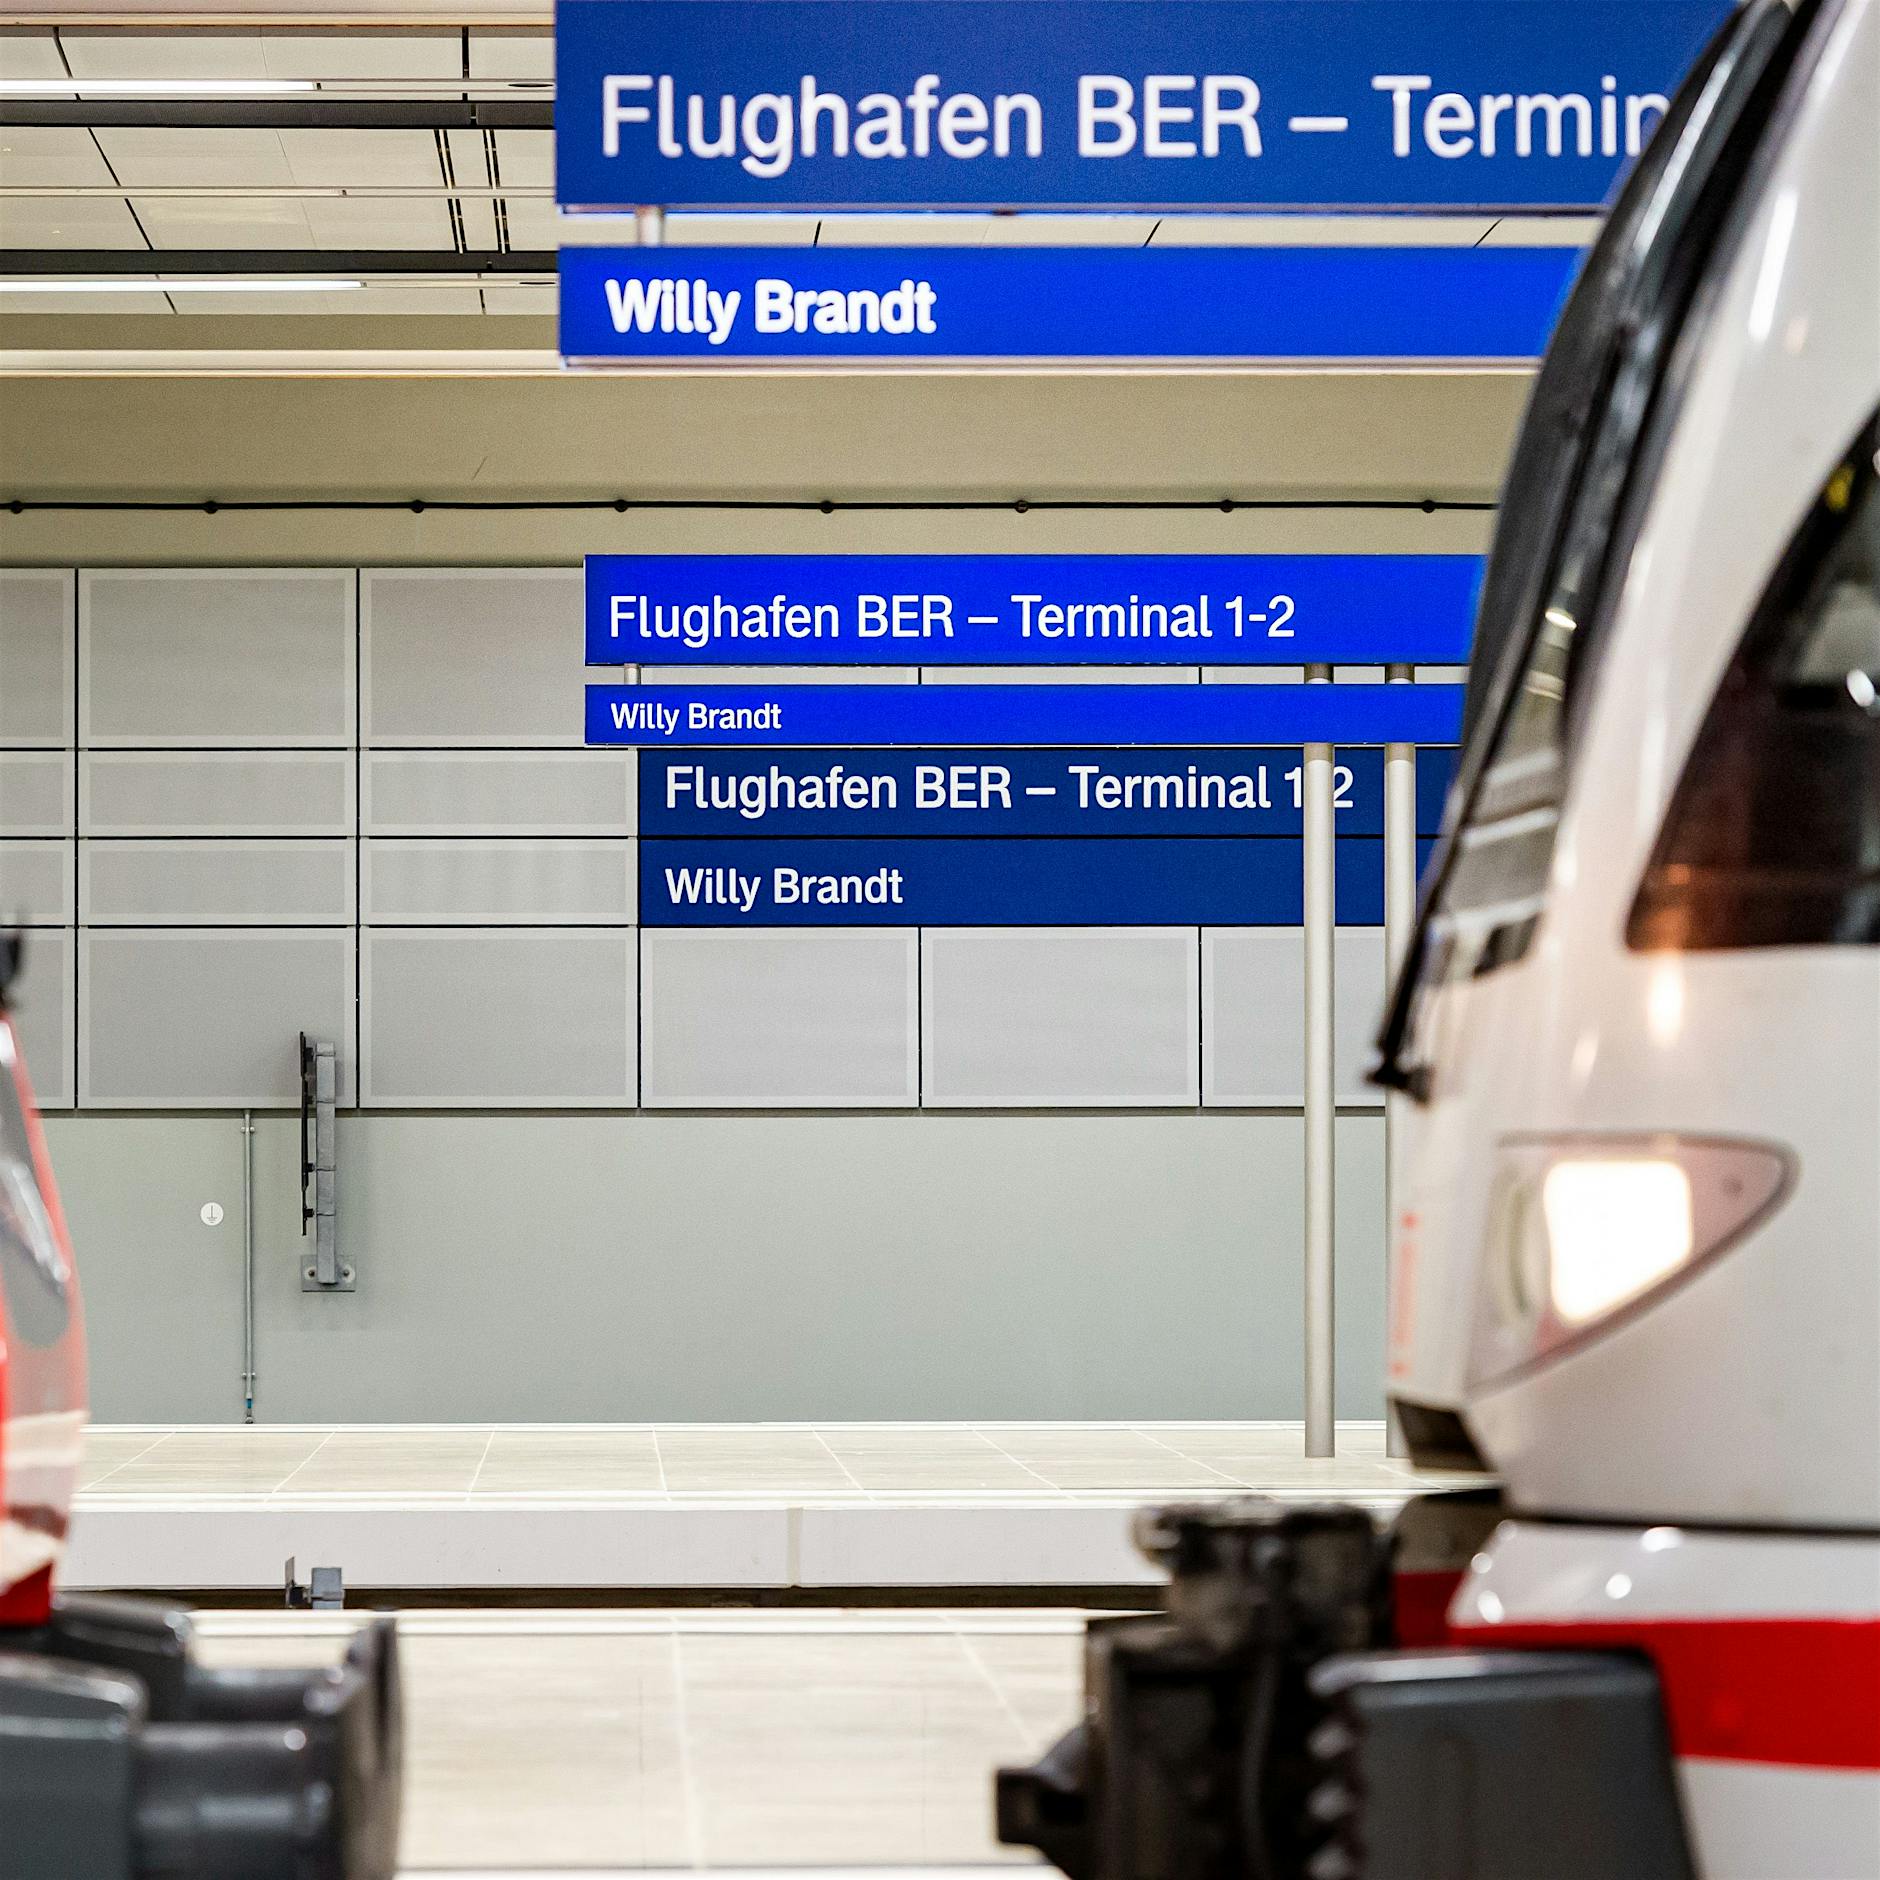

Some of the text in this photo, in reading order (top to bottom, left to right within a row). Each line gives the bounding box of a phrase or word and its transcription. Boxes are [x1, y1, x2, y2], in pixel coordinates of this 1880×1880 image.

[601, 74, 1044, 179] Flughafen
[1076, 74, 1264, 159] BER
[604, 278, 938, 345] Willy Brandt
[609, 594, 839, 649] Flughafen
[858, 594, 954, 638] BER
[1010, 594, 1213, 638] Terminal
[1225, 594, 1296, 638] 1-2
[610, 702, 782, 736] Willy Brandt
[666, 765, 897, 819] Flughafen
[915, 765, 1012, 809] BER
[1068, 765, 1272, 809] Terminal
[1284, 765, 1354, 809] 12
[664, 867, 904, 913] Willy Brandt
